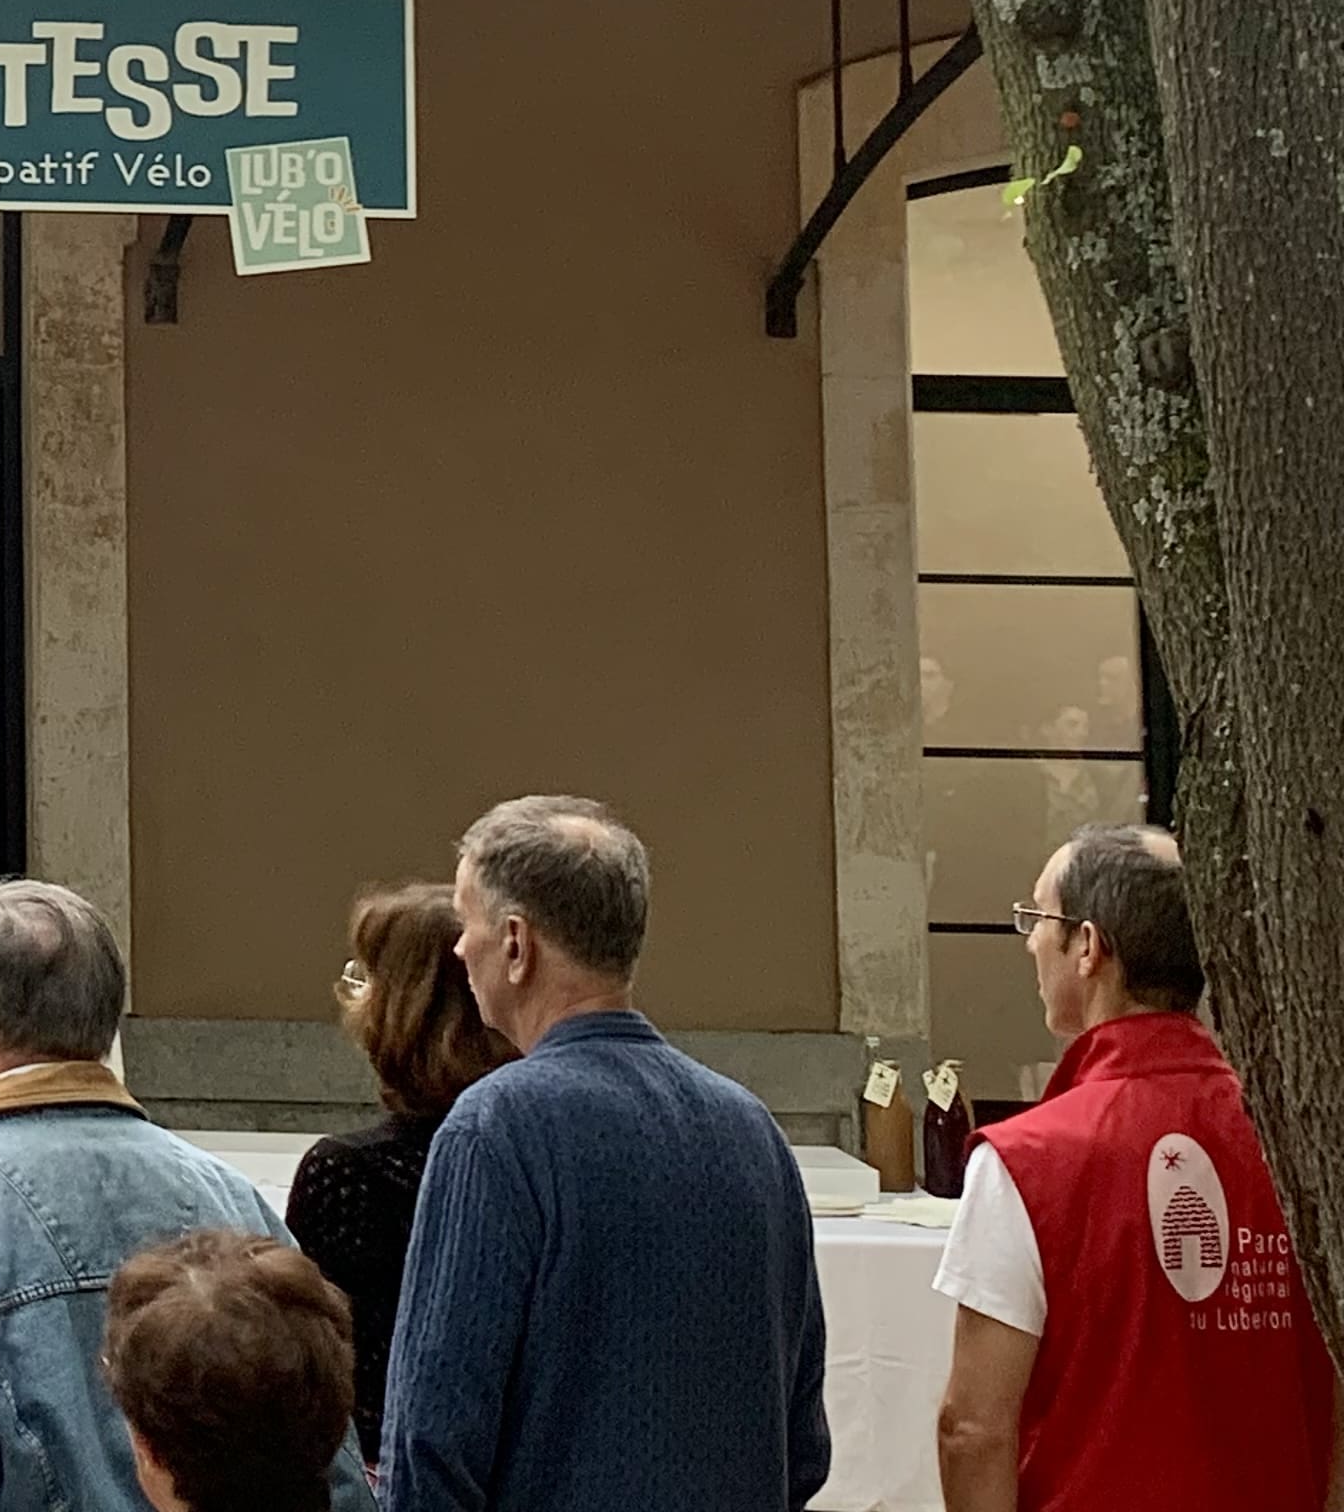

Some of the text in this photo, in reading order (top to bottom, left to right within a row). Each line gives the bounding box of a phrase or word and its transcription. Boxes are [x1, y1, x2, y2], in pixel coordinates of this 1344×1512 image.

[113, 151, 212, 188] Vélo
[240, 146, 343, 195] LUB'O
[241, 189, 344, 257] VÉLO
[1237, 1227, 1289, 1255] Parc
[1216, 1306, 1292, 1331] Luberon
